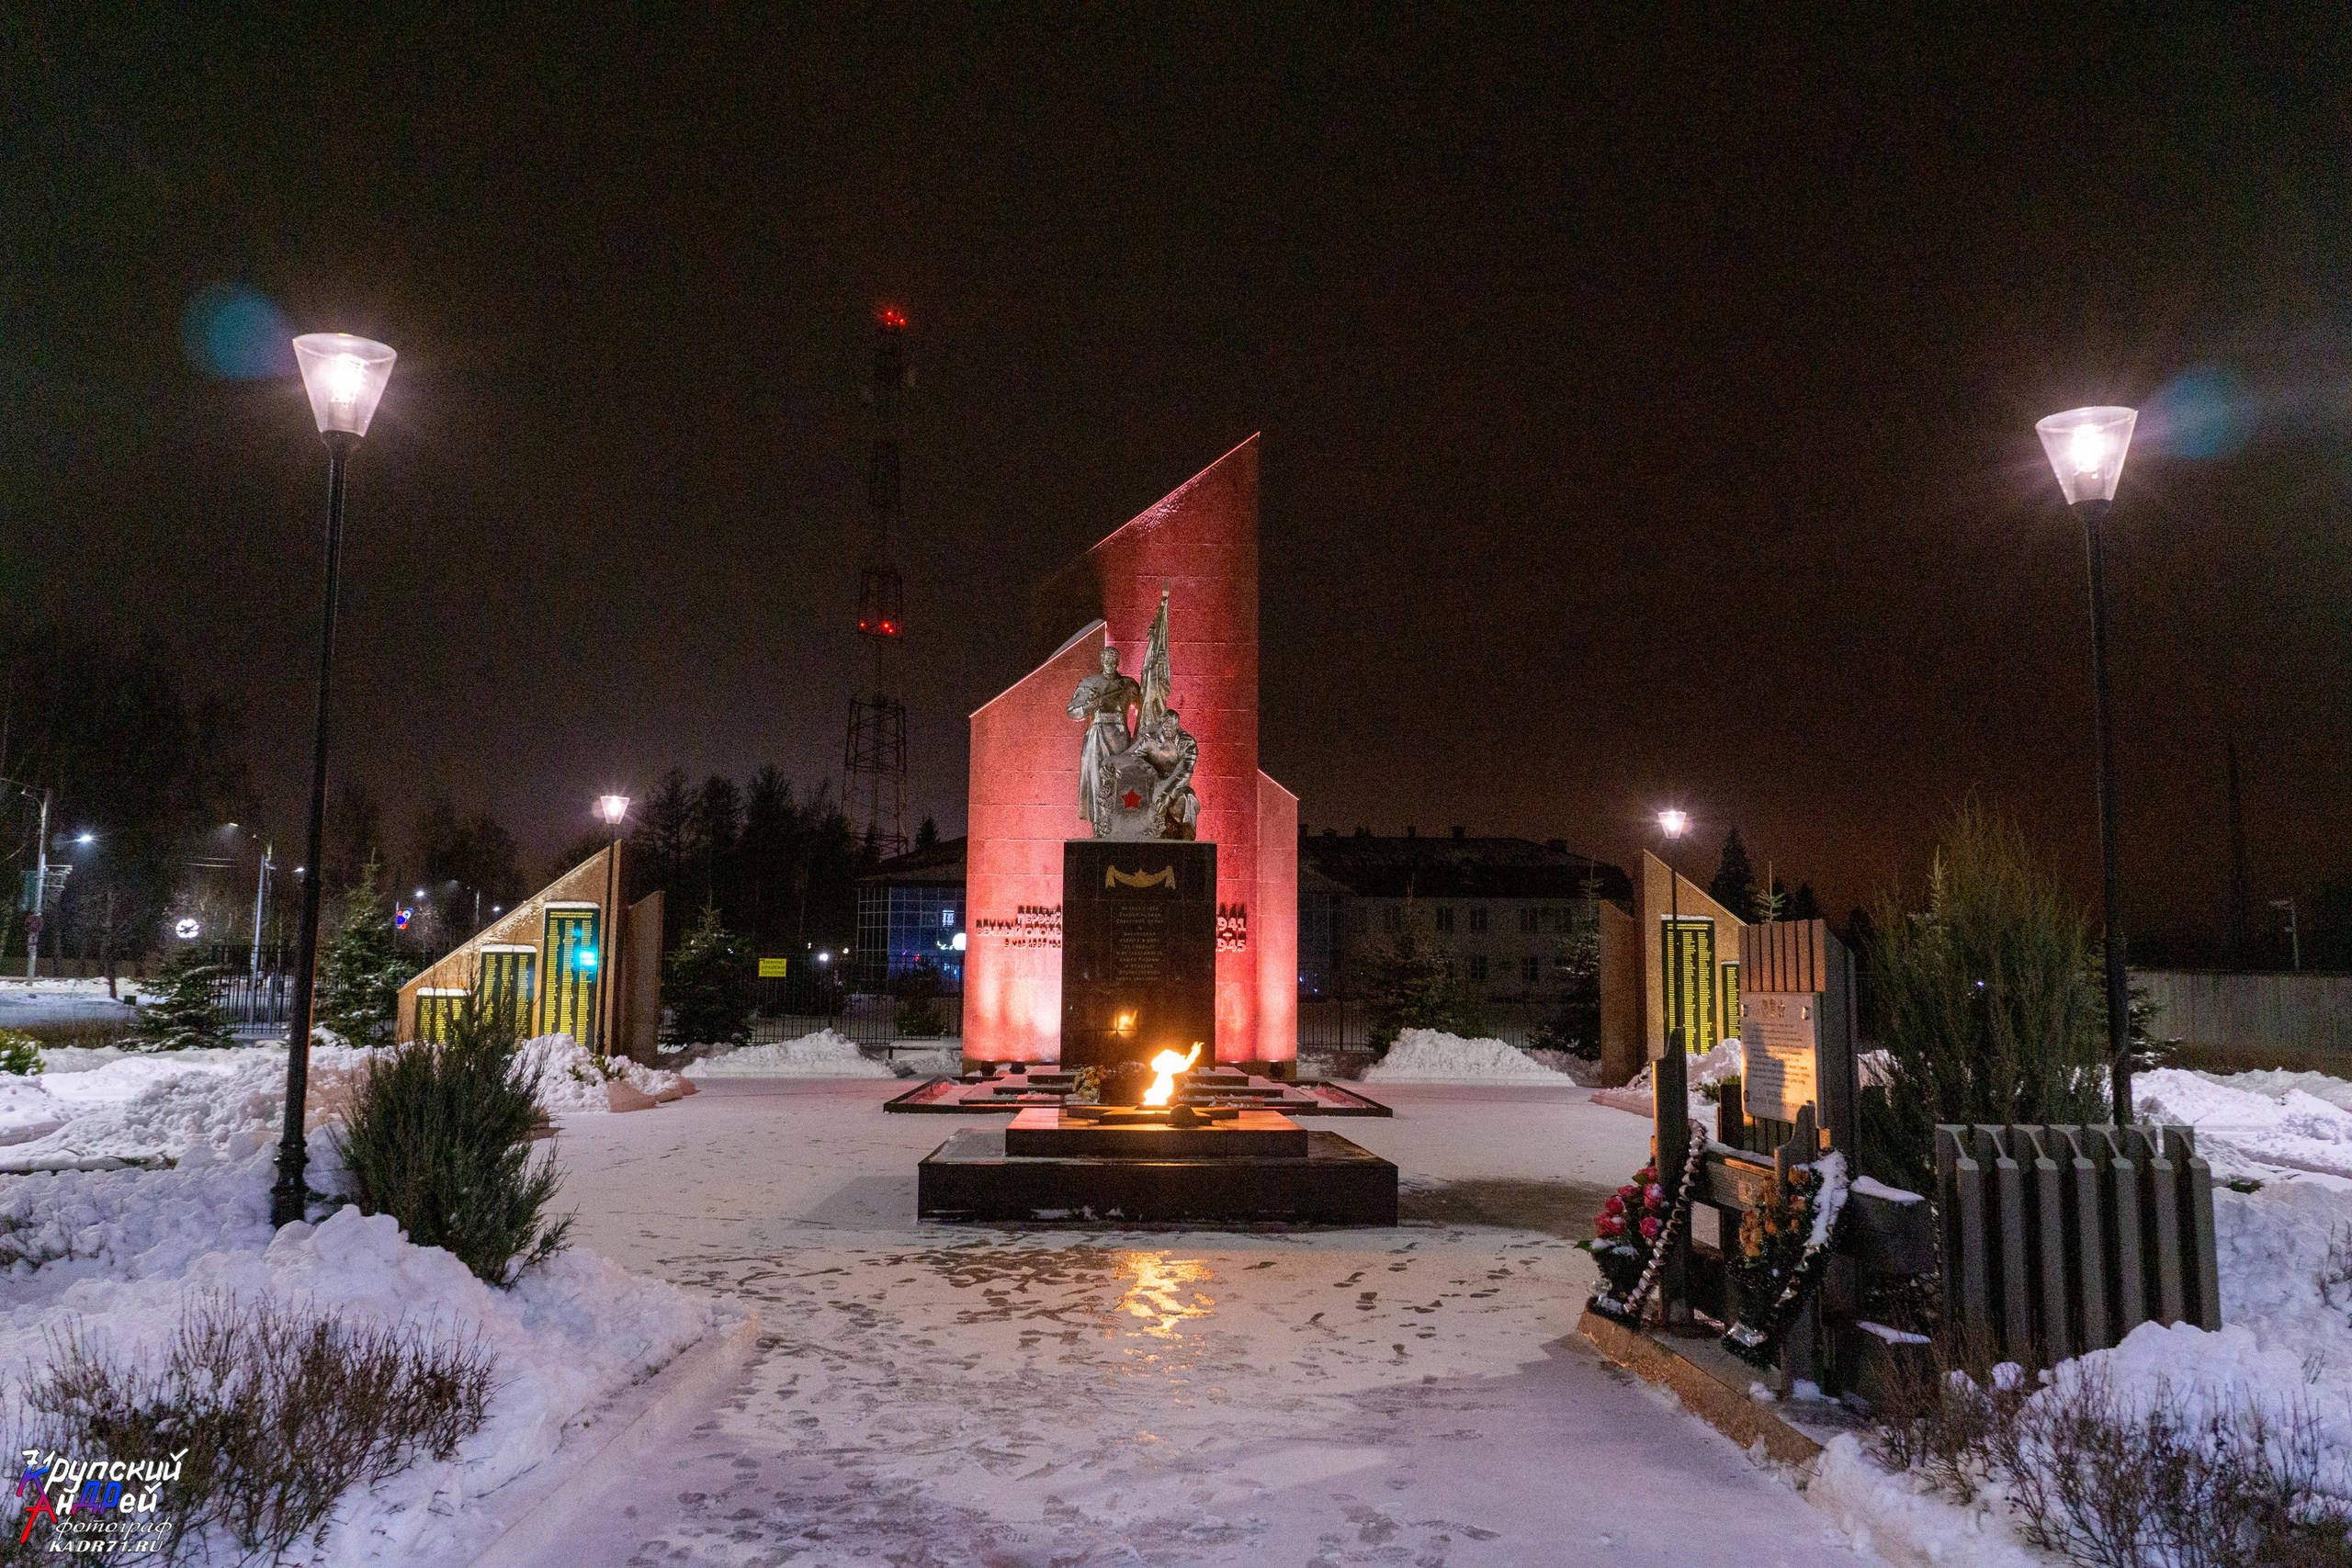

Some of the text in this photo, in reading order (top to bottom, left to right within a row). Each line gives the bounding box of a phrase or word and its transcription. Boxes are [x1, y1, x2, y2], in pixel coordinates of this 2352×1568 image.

[1017, 912, 1061, 924] ПЕРВЫЙ
[1216, 917, 1247, 931] 941
[976, 924, 1061, 936] ВЕЧНЫЙ ОГОНЬ
[1216, 938, 1246, 952] 945
